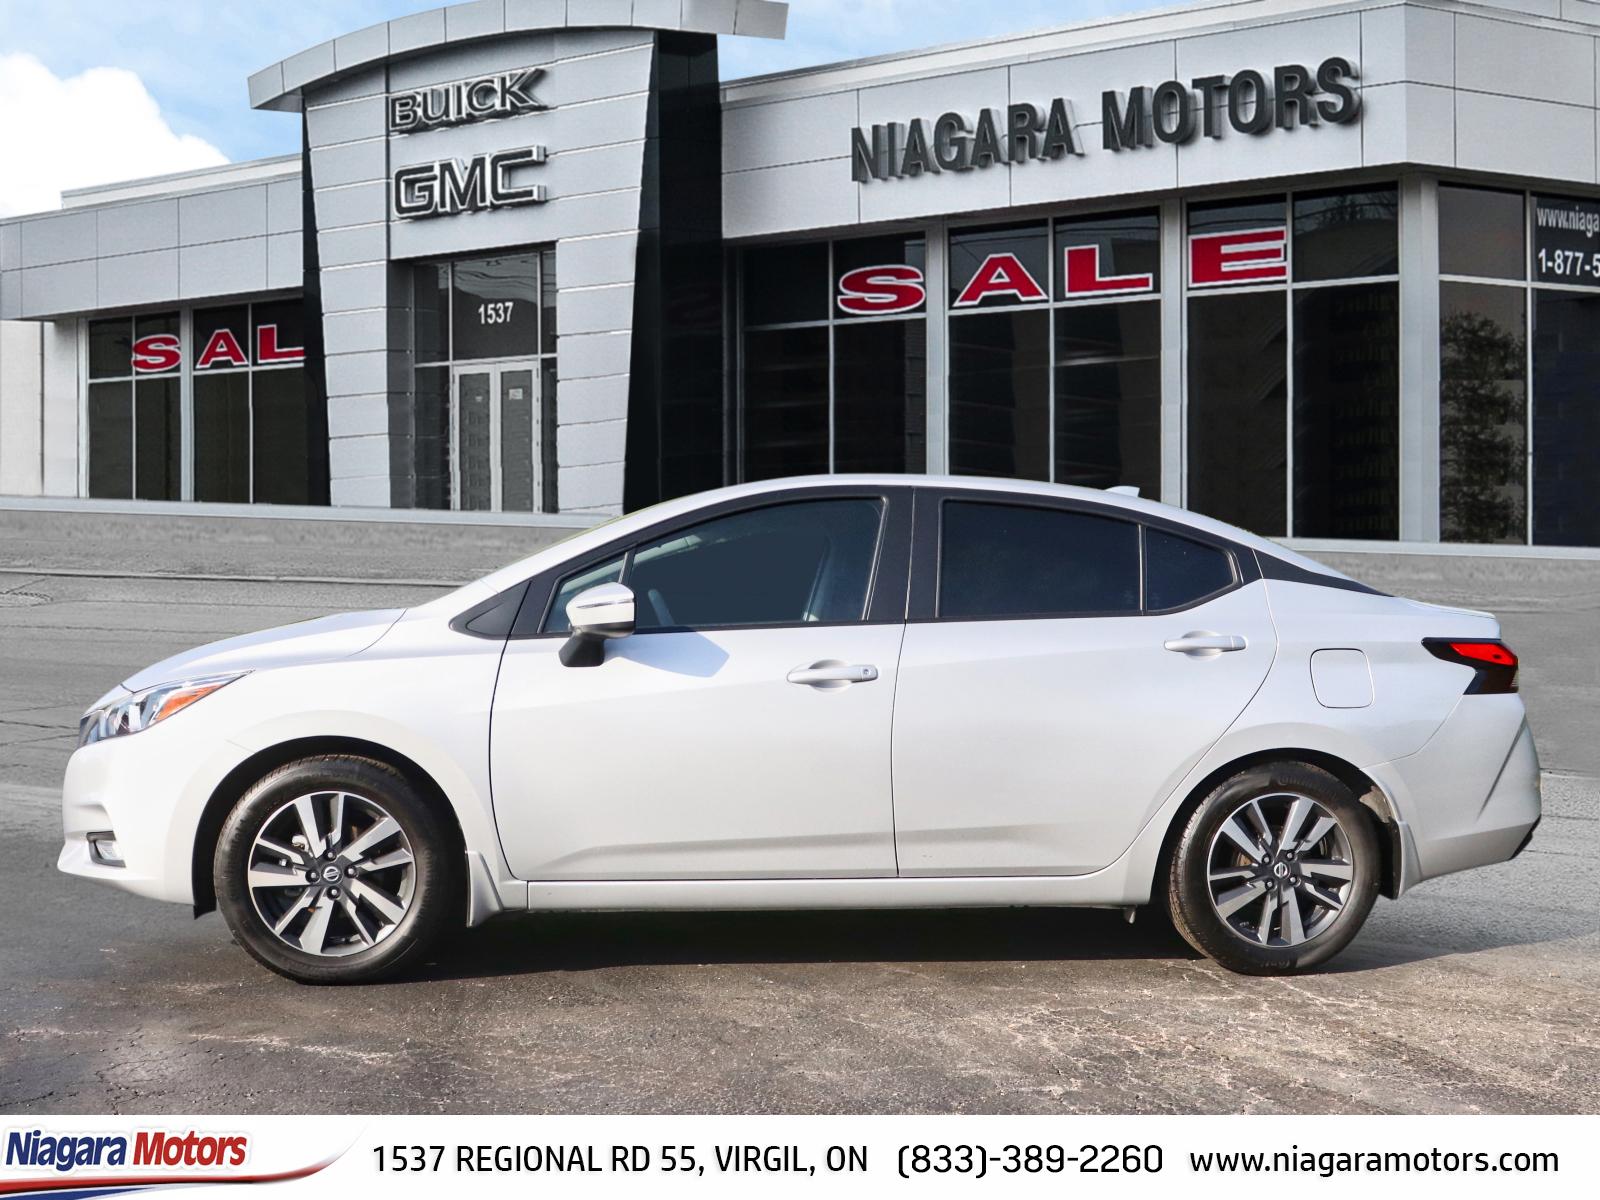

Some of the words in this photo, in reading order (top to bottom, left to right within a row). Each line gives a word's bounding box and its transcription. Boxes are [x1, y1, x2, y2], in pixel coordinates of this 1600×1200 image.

[389, 68, 548, 133] BUICK
[851, 98, 1085, 183] NIAGARA
[1102, 57, 1361, 151] MOTORS
[393, 145, 547, 218] GMC
[837, 226, 1287, 315] SALE
[478, 302, 514, 325] 1537
